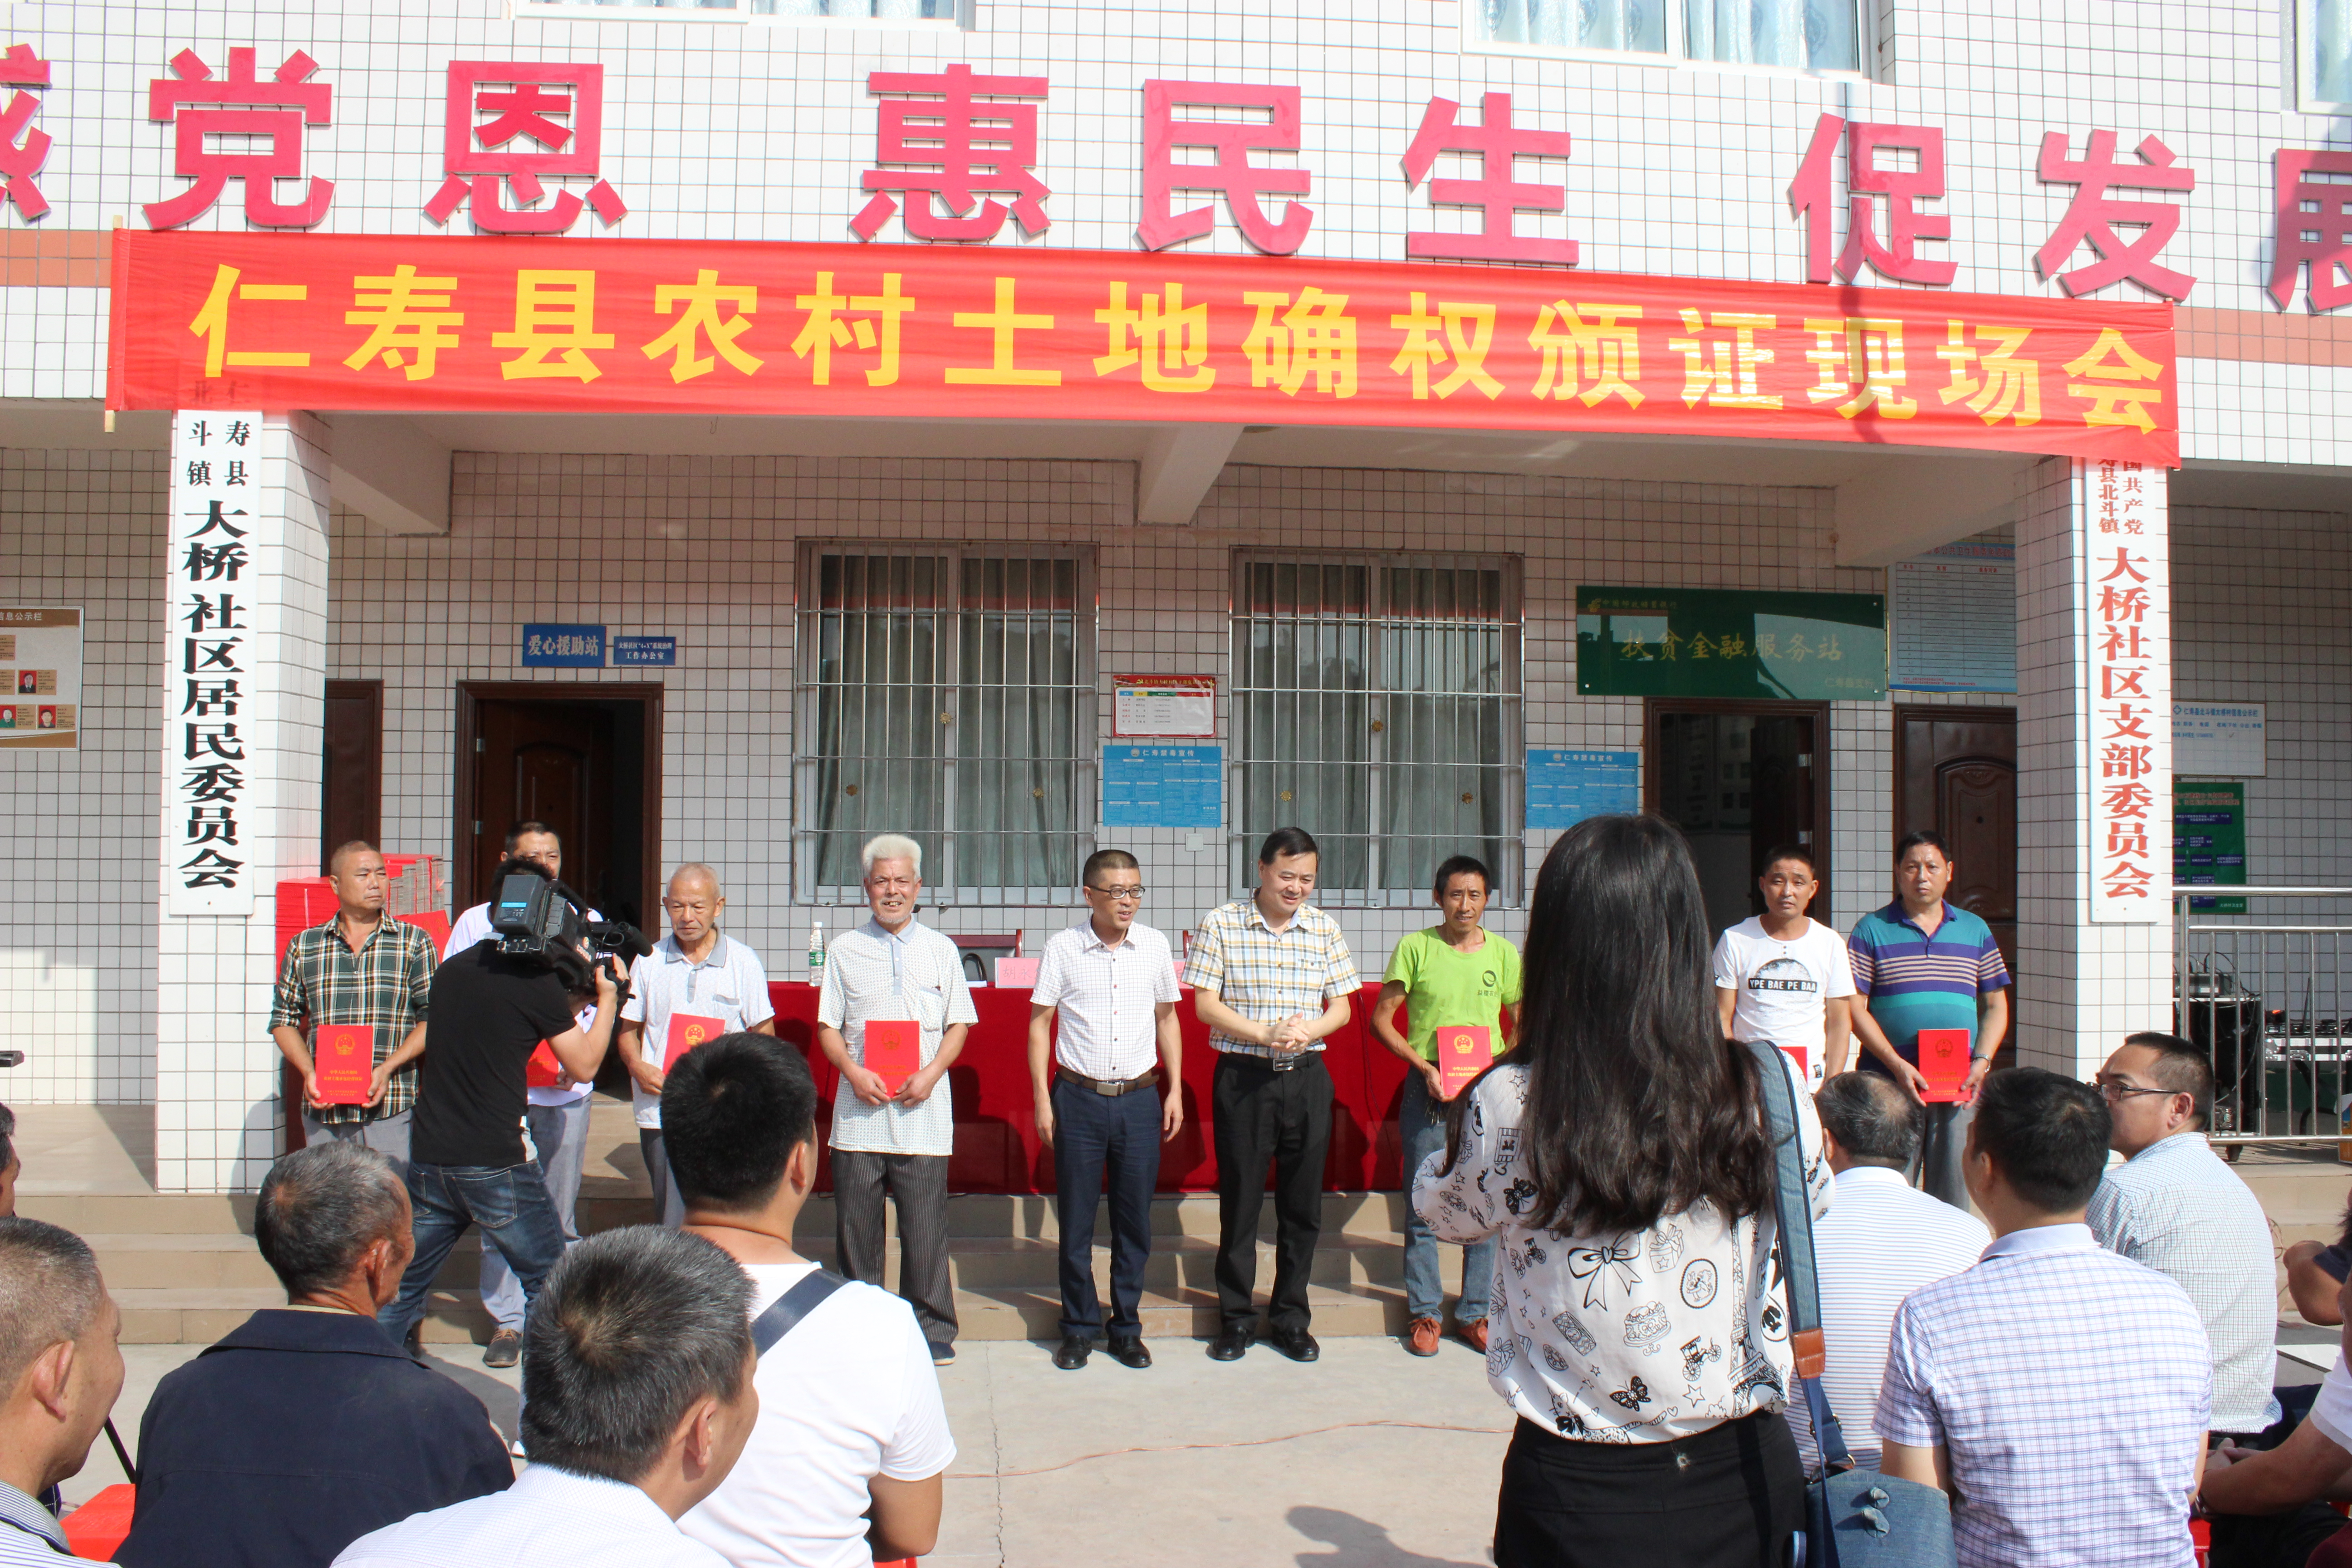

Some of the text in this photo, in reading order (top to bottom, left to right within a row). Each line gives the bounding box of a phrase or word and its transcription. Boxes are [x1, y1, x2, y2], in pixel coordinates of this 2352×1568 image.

[189, 264, 2165, 436] 仁寿县农村土地确权颁证现场会
[528, 634, 599, 657] 爱心援助站
[626, 651, 665, 660] 工作办公室
[1621, 627, 1843, 662] 扶贫金融服务站
[177, 500, 250, 889] 大桥社区居民委员会
[2096, 546, 2155, 899] 大桥社区支部委员会
[1003, 965, 1037, 980] 胡永
[1767, 980, 1784, 990] BAE
[1787, 981, 1798, 990] PE
[1801, 981, 1816, 992] BAA
